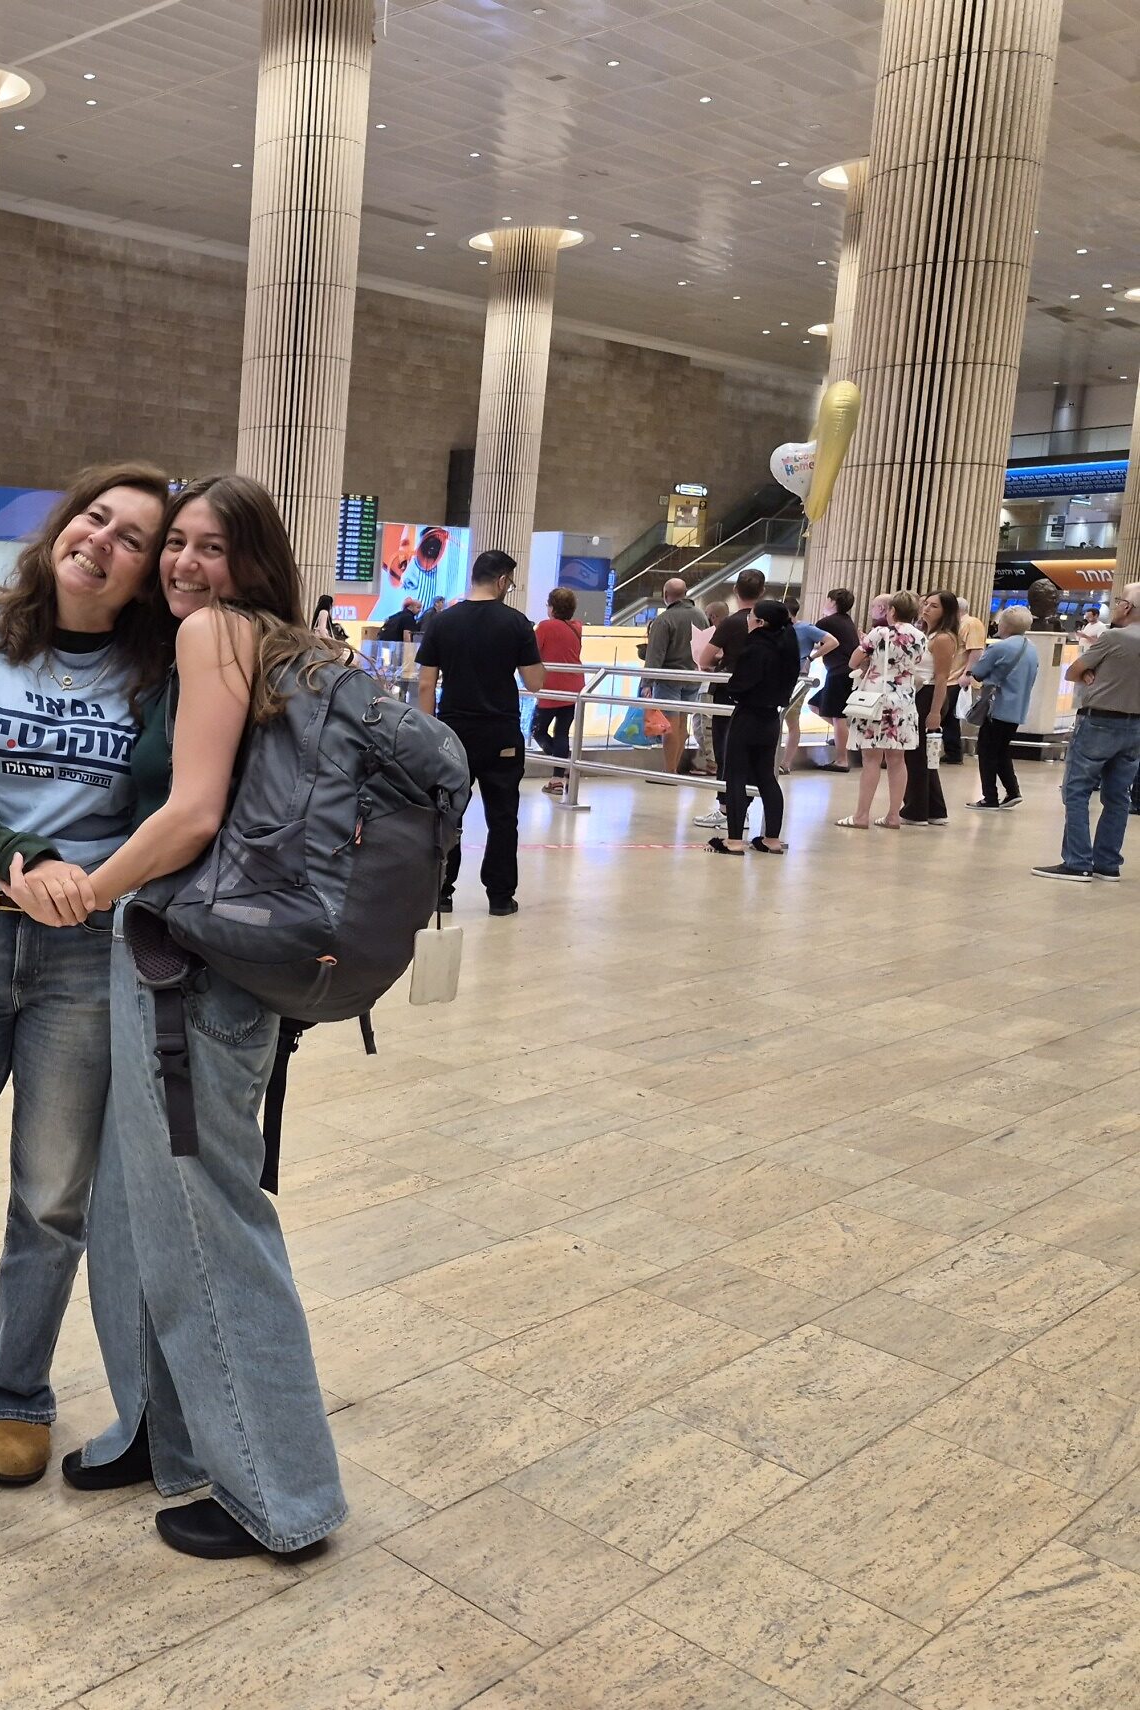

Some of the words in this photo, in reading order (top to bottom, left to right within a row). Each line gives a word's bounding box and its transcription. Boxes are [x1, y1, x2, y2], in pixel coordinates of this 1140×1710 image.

[25, 691, 66, 717] אני
[70, 698, 105, 719] גם
[29, 765, 52, 777] יאיר
[59, 769, 112, 786] הדמוקרטים
